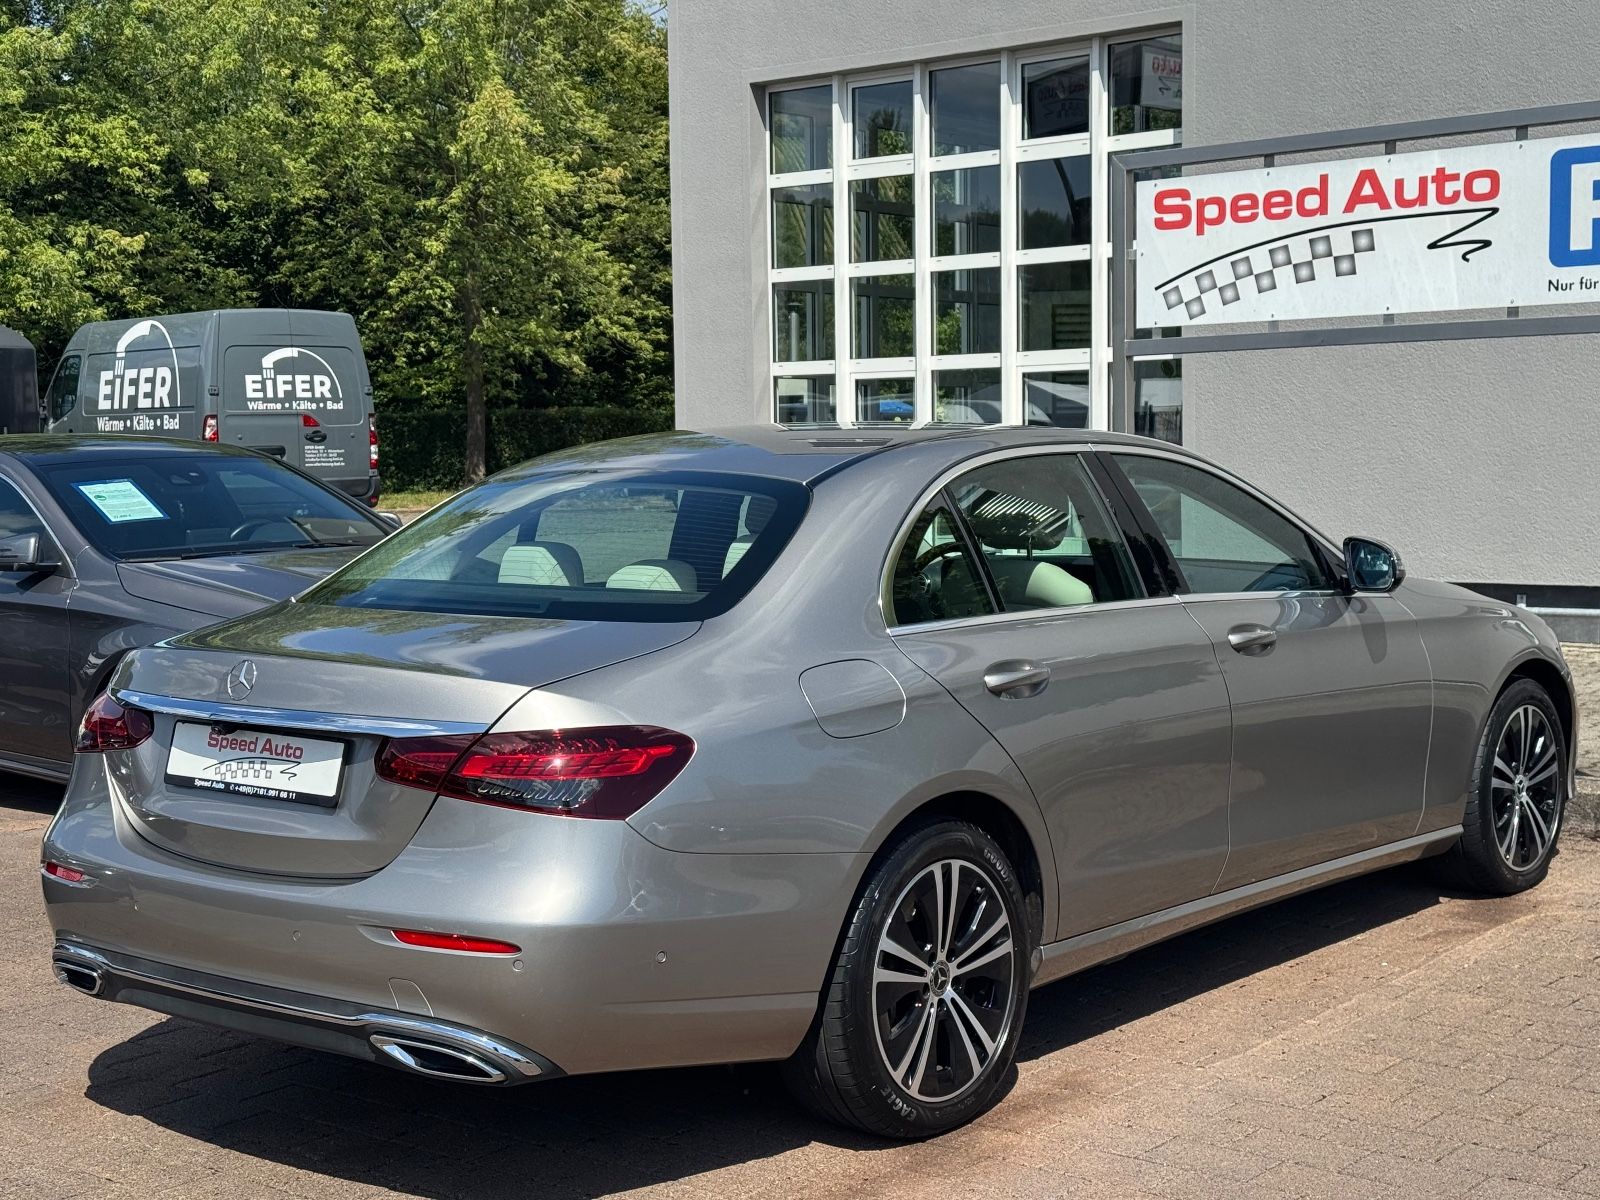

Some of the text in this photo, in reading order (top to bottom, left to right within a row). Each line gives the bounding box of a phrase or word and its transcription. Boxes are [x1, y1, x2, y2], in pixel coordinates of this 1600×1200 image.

[1154, 167, 1500, 236] Speed Auto
[1548, 276, 1599, 292] Nur für
[247, 400, 343, 410] Wärme Kälte Bad
[97, 413, 180, 432] Wärme Kälte Bad
[207, 730, 303, 759] Speed Auto
[194, 778, 211, 787] Speed
[211, 780, 225, 789] Auto
[880, 1084, 917, 1121] EAGLE
